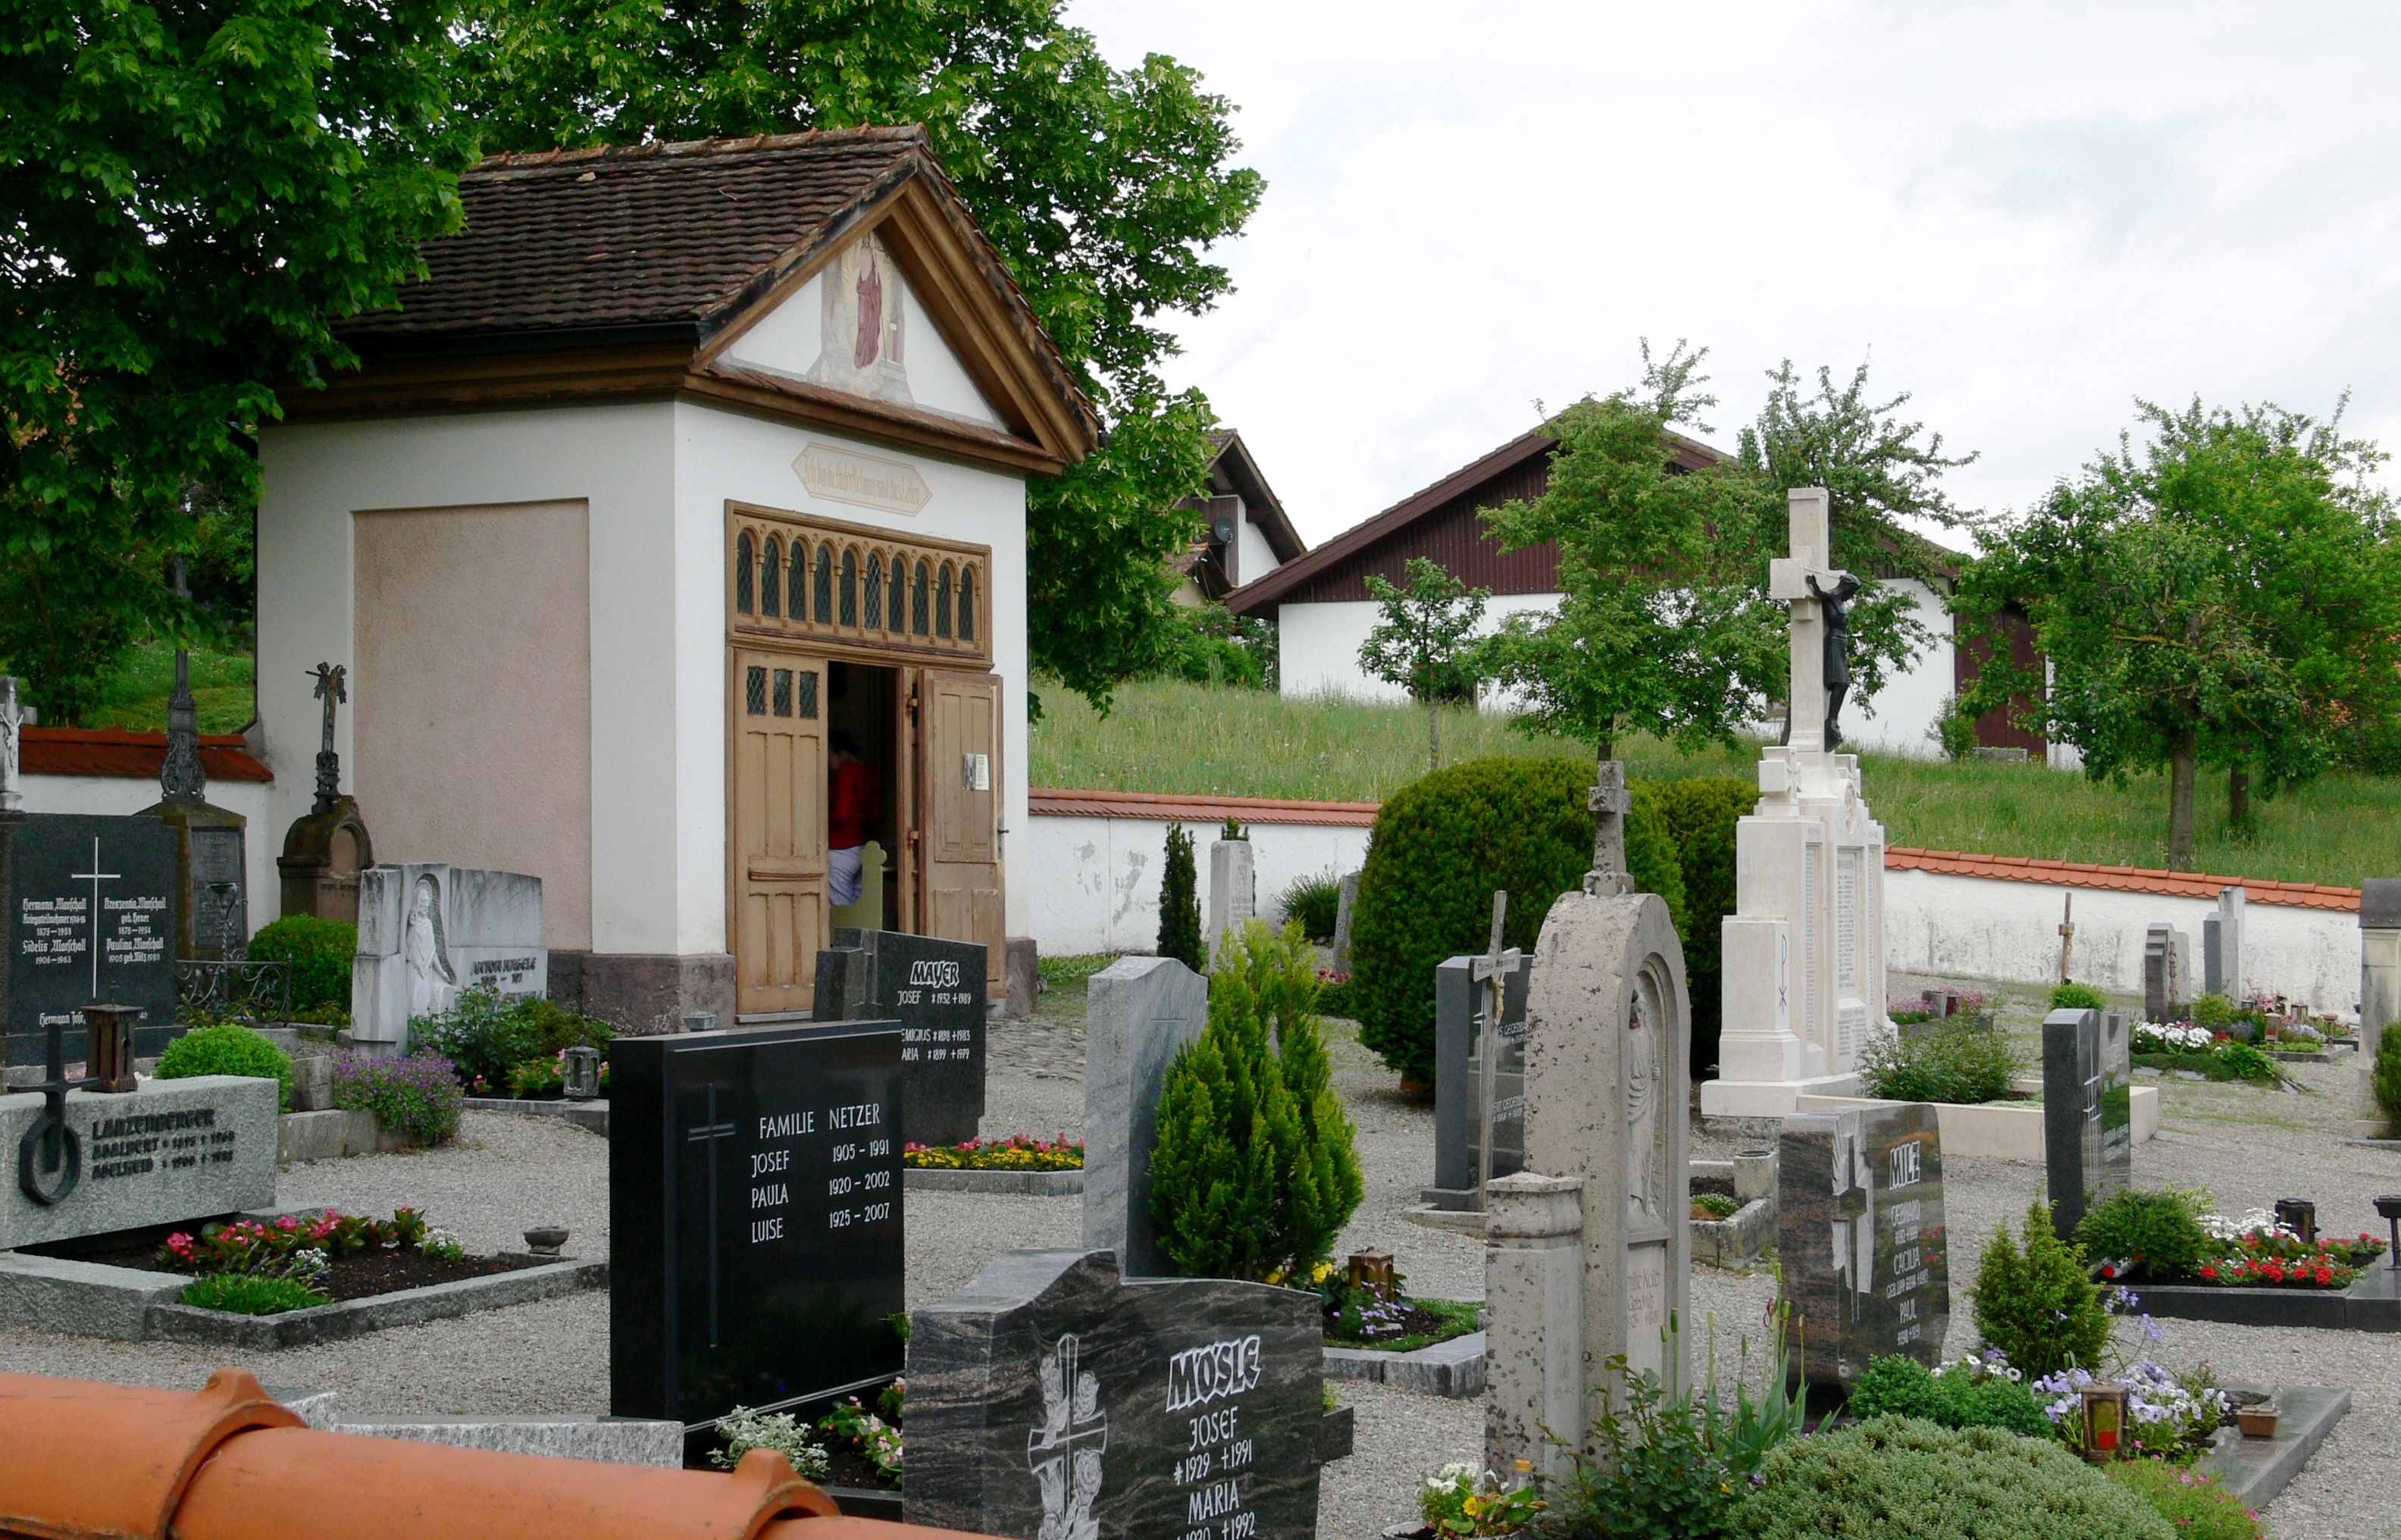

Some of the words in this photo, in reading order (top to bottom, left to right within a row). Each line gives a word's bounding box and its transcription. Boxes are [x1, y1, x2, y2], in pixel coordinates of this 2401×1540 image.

[23, 897, 54, 912] Hermann
[22, 939, 49, 955] Fidelis
[909, 959, 960, 988] MAYER
[897, 990, 922, 1006] JOSEF
[39, 1012, 70, 1028] Hermann
[900, 1028, 931, 1042] EMIGIUS
[901, 1047, 919, 1061] ARIA
[759, 1110, 815, 1140] FAMILIE
[829, 1102, 881, 1131] NETZER
[92, 1137, 159, 1160] ADALBERT
[750, 1149, 790, 1178] JOSEF
[832, 1143, 856, 1163] 1905
[869, 1138, 890, 1157] 1991
[92, 1157, 153, 1179] ADELHEID
[1889, 1140, 1920, 1191] MILZ
[751, 1182, 789, 1209] PAULA
[828, 1176, 852, 1196] 1920
[864, 1170, 891, 1191] 2002
[751, 1217, 784, 1244] LUISE
[829, 1209, 850, 1229] 1925
[864, 1202, 891, 1222] 2007
[1642, 1269, 1660, 1290] Kolb
[1899, 1297, 1917, 1324] PAUL
[1188, 1405, 1238, 1453] JOSEF
[1187, 1479, 1240, 1526] MARIA
